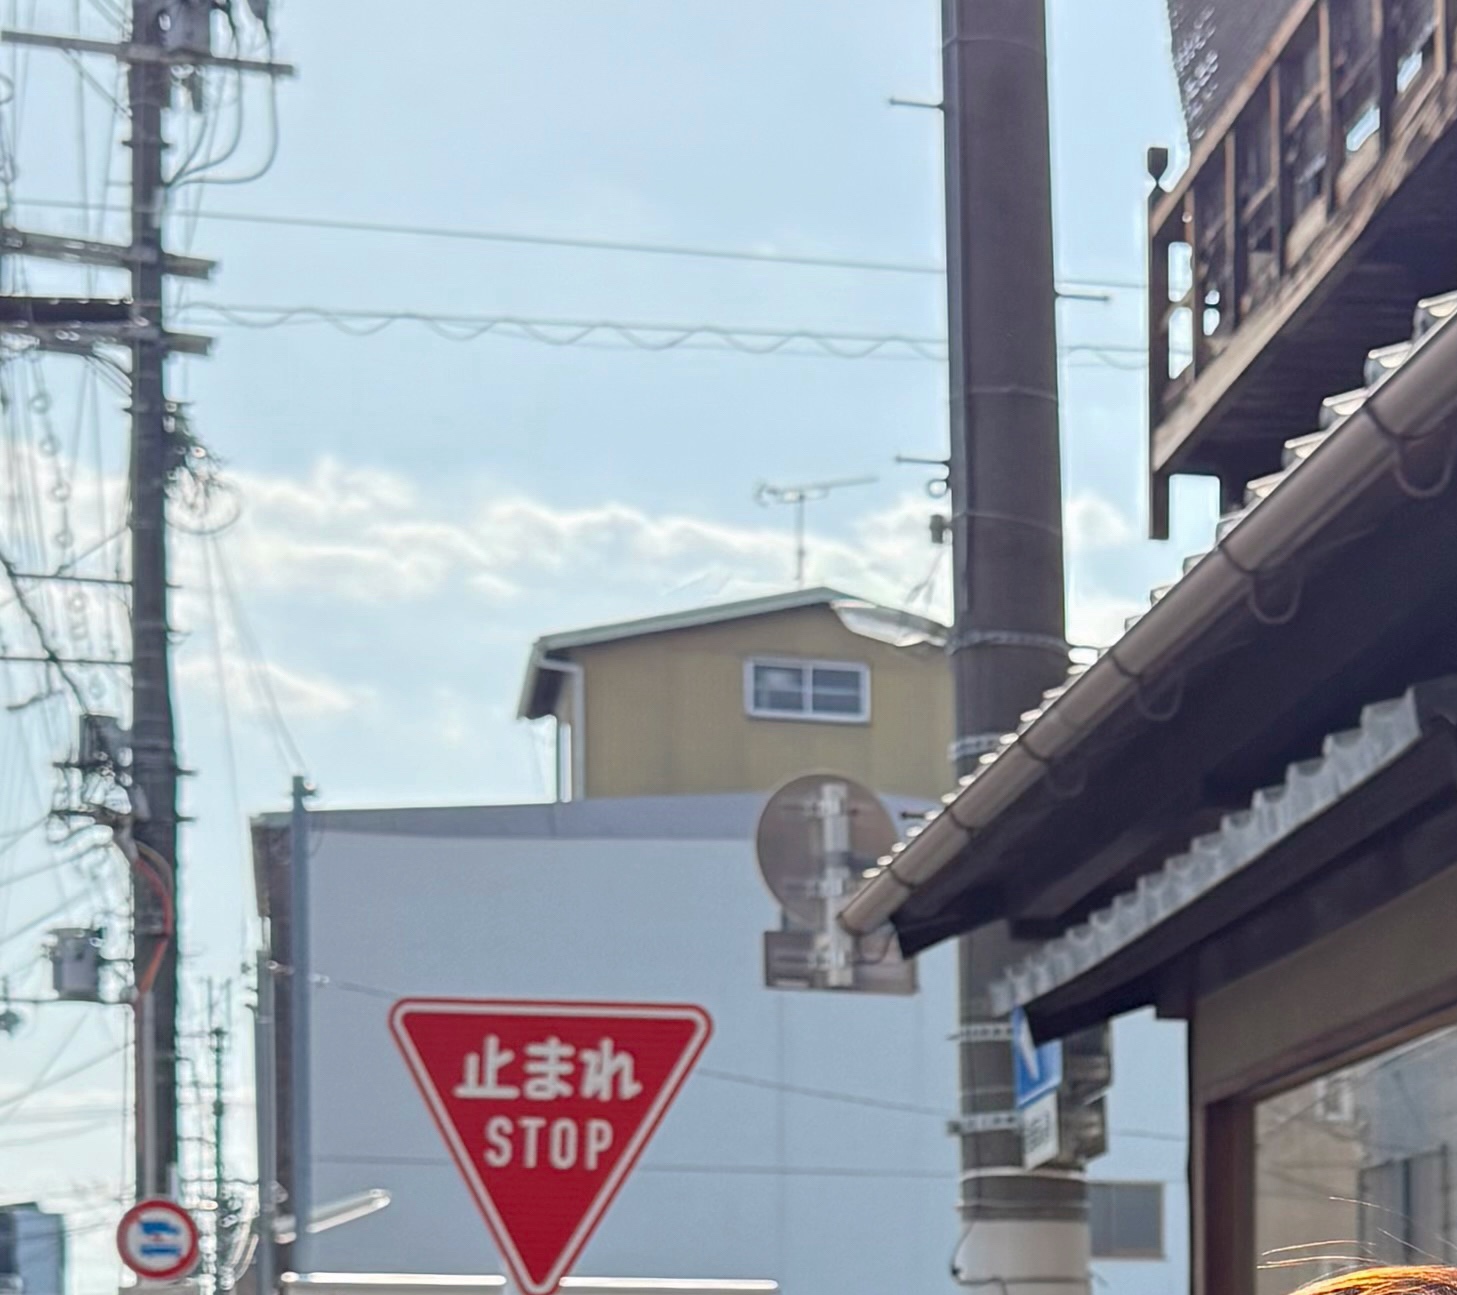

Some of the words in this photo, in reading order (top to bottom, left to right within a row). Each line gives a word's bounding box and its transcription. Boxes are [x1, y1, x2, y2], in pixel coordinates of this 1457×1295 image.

[454, 1034, 643, 1101] 止まれ
[484, 1116, 613, 1170] STOP
